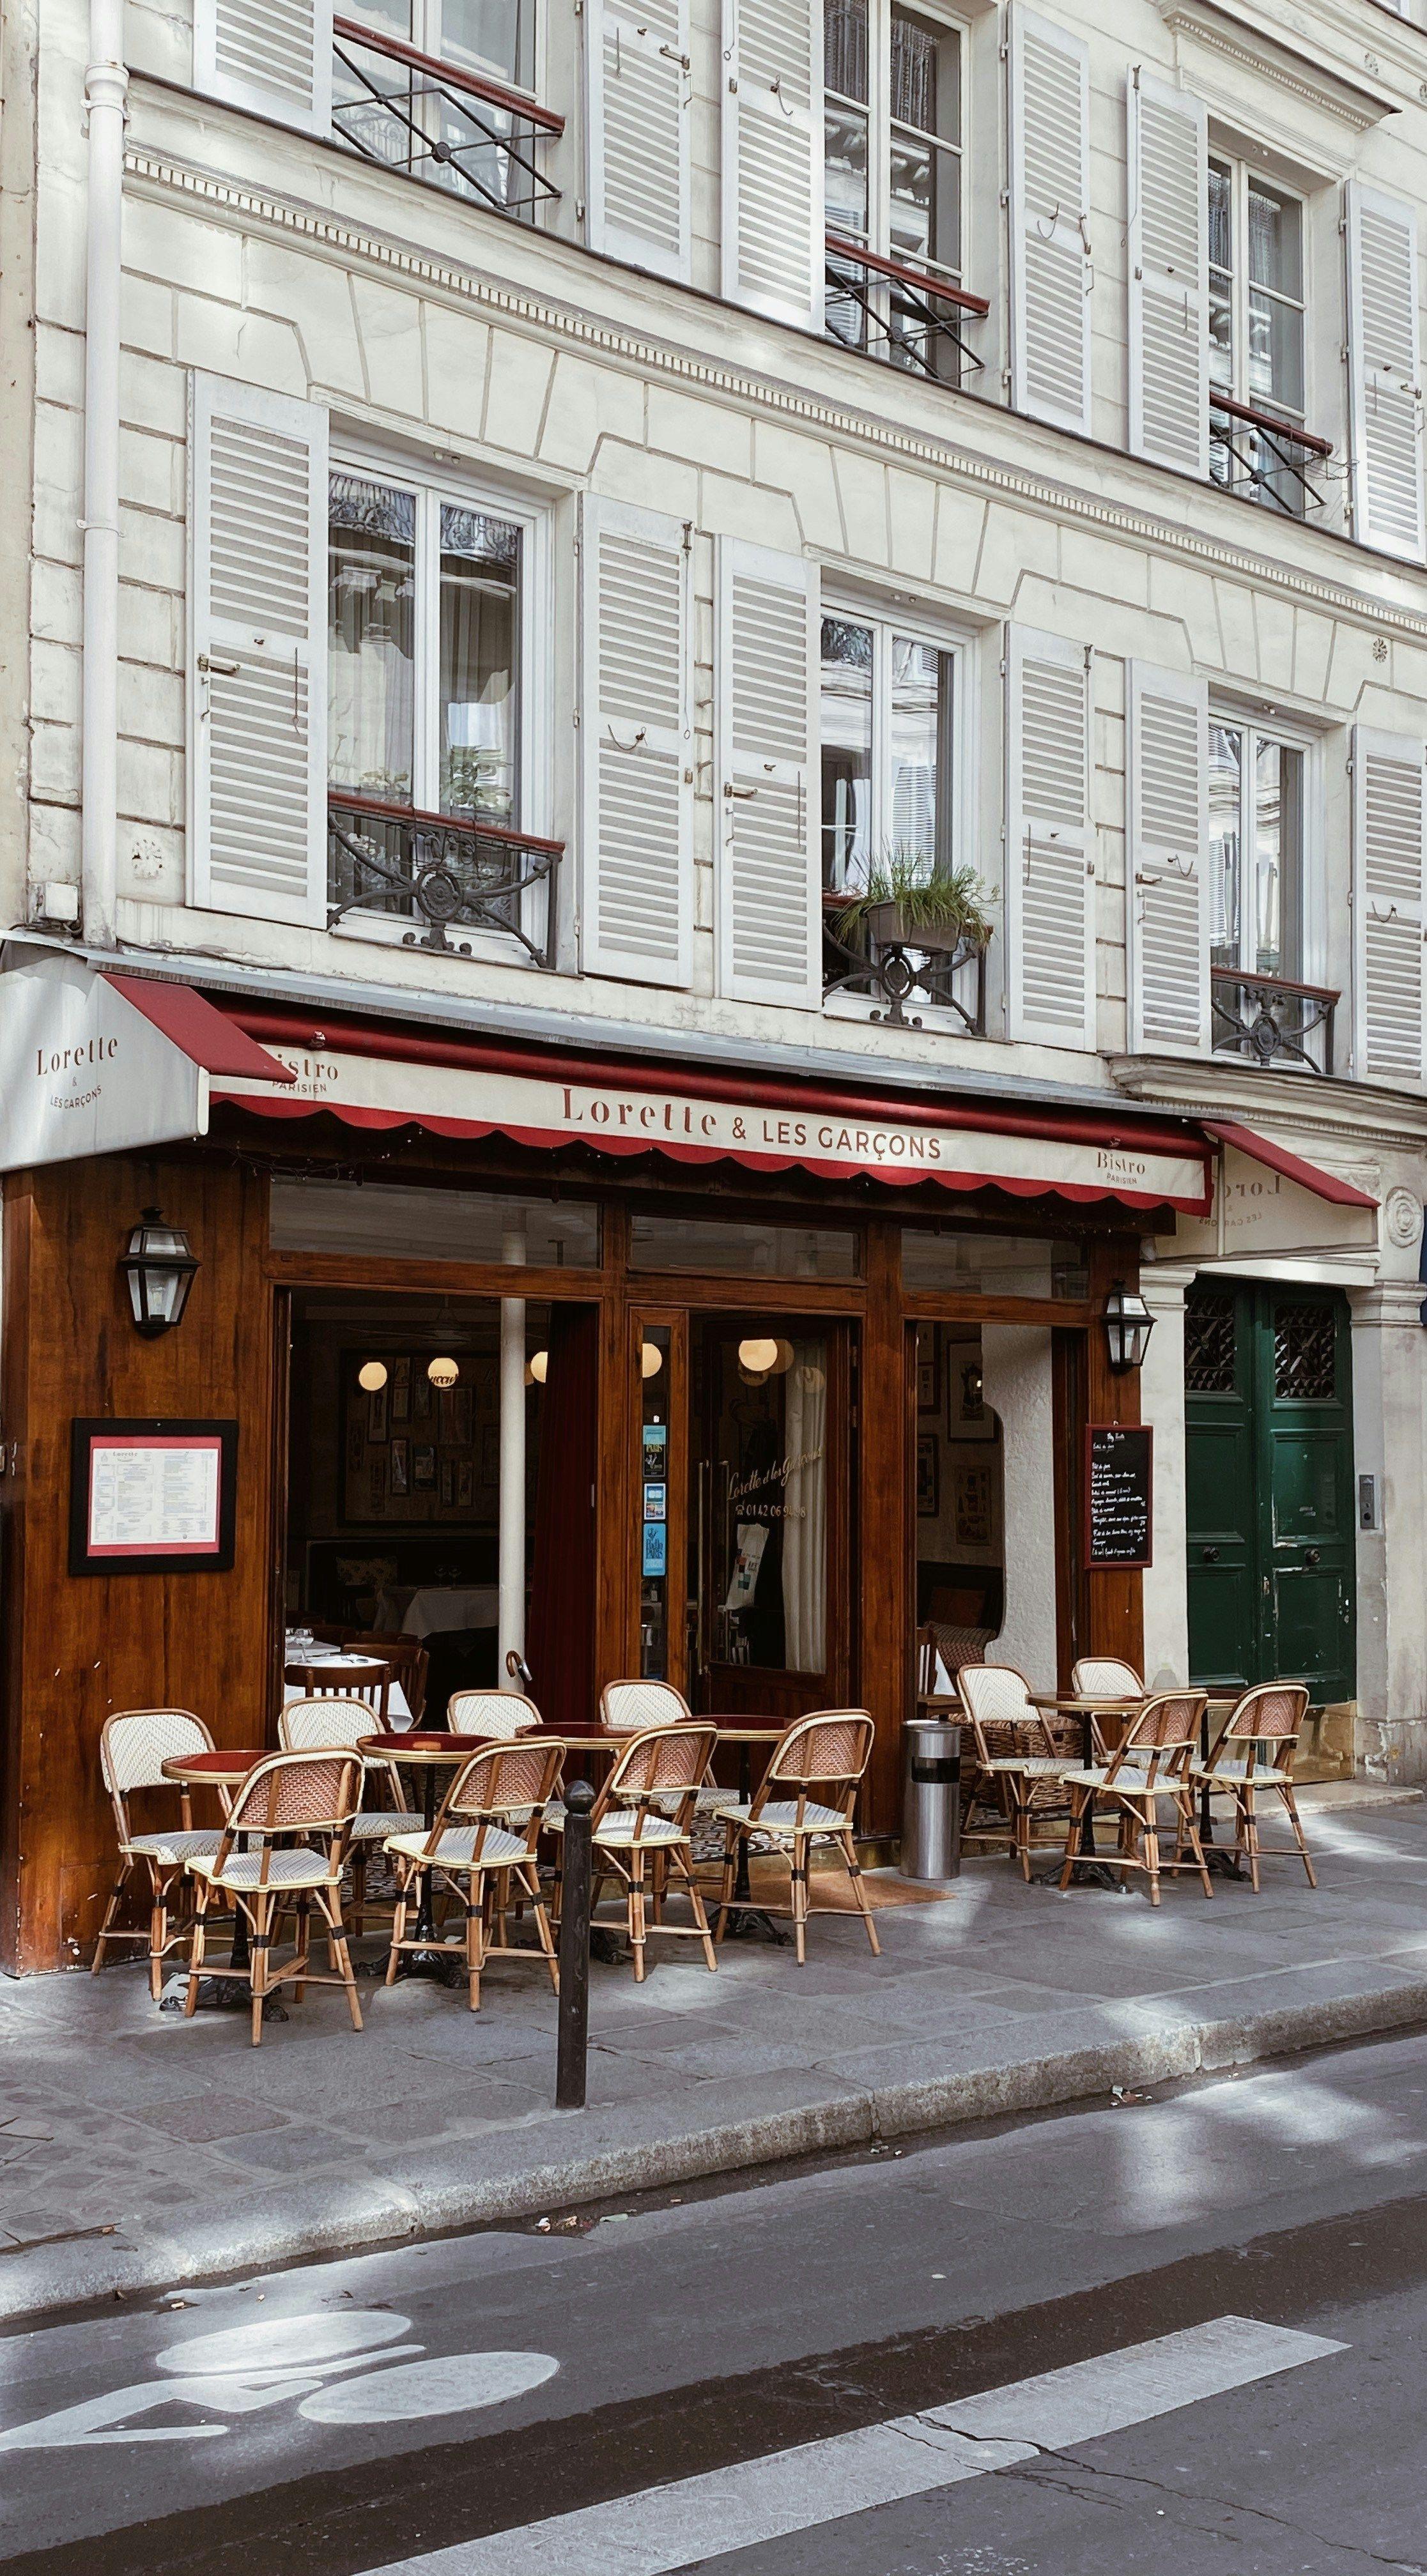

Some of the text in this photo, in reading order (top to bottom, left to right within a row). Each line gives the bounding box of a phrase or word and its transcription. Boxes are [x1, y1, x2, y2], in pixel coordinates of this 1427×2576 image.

[36, 1036, 118, 1076] Lorette
[72, 1076, 78, 1087] &
[50, 1085, 102, 1109] LES GARÇONS
[562, 1088, 941, 1161] Lorette & LES GARÇONS
[1097, 1152, 1146, 1175] Bistro
[1106, 1172, 1138, 1185] PARISIEN
